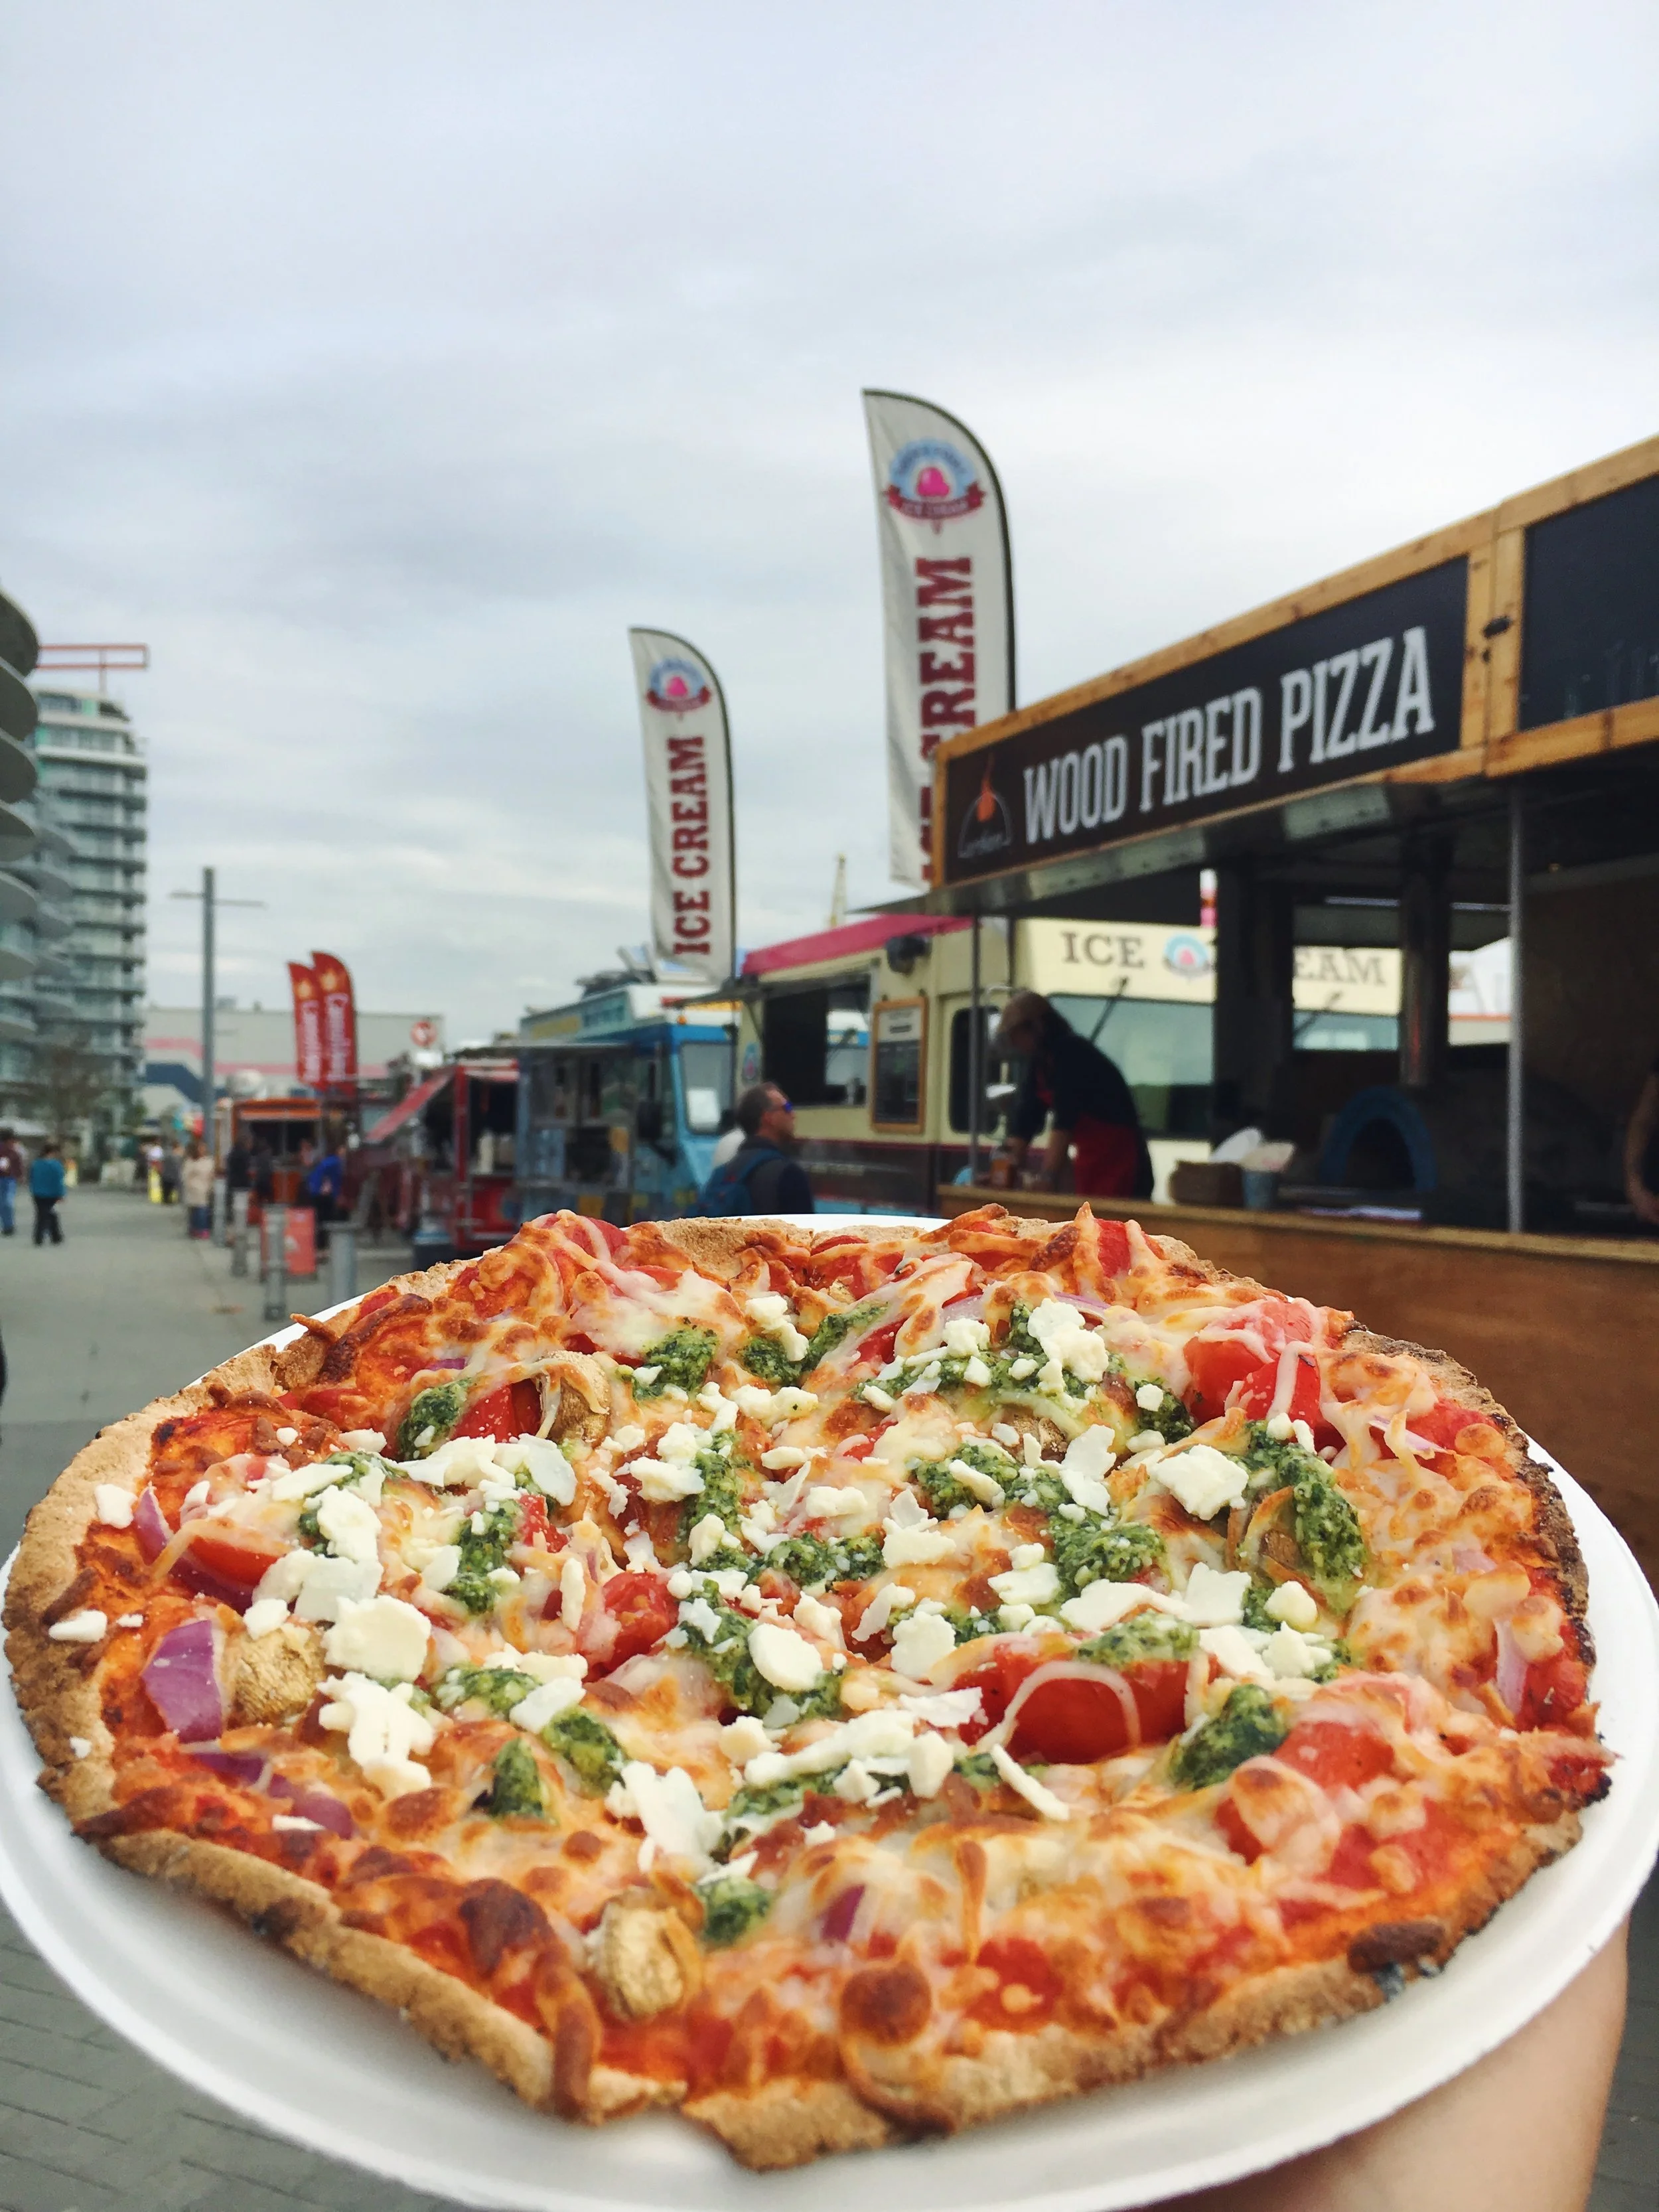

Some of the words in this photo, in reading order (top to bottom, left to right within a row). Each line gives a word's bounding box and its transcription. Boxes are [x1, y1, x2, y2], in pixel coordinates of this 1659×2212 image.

[1023, 735, 1127, 845] WOOD
[1139, 687, 1262, 813] FIRED
[1277, 626, 1435, 773] PIZZA
[667, 736, 709, 878] CREAM
[673, 891, 711, 954] ICE
[1060, 931, 1145, 968] ICE
[1293, 949, 1387, 986] EAM
